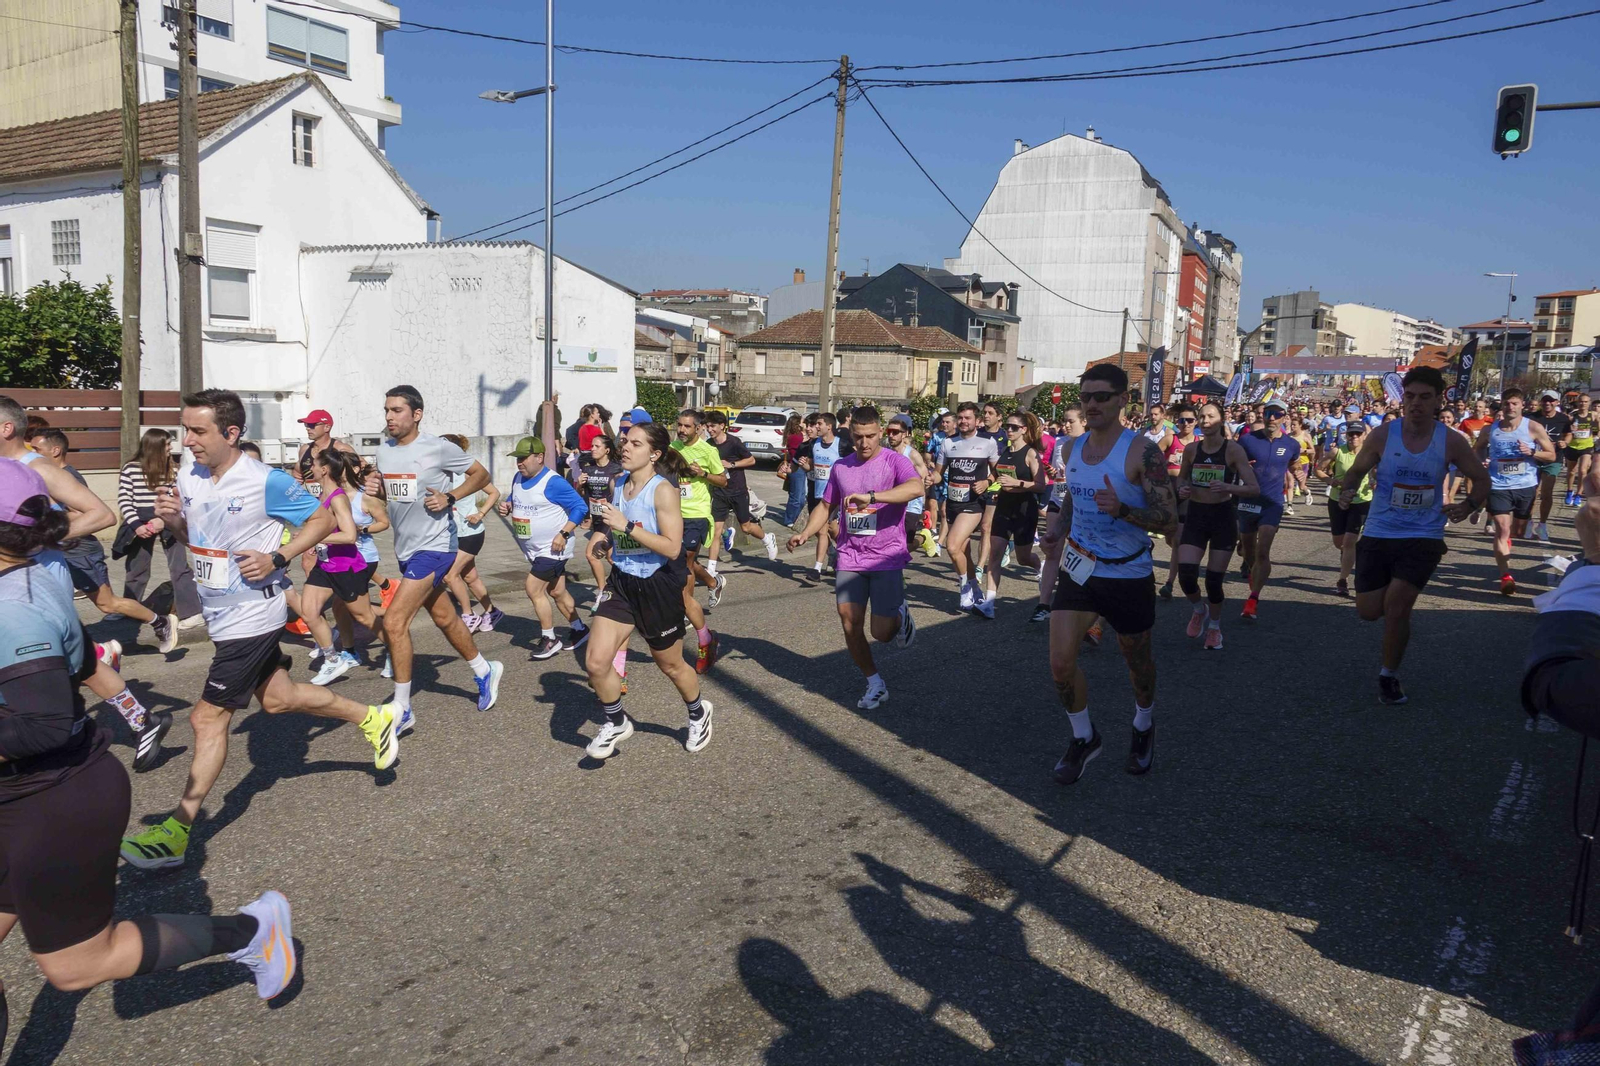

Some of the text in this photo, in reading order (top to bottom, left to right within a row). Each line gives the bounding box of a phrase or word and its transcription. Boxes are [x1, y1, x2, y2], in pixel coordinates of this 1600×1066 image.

[389, 483, 409, 497] 1013
[1403, 492, 1424, 506] 621
[848, 516, 870, 530] 1024
[1064, 551, 1083, 572] 511
[196, 560, 213, 580] 917
